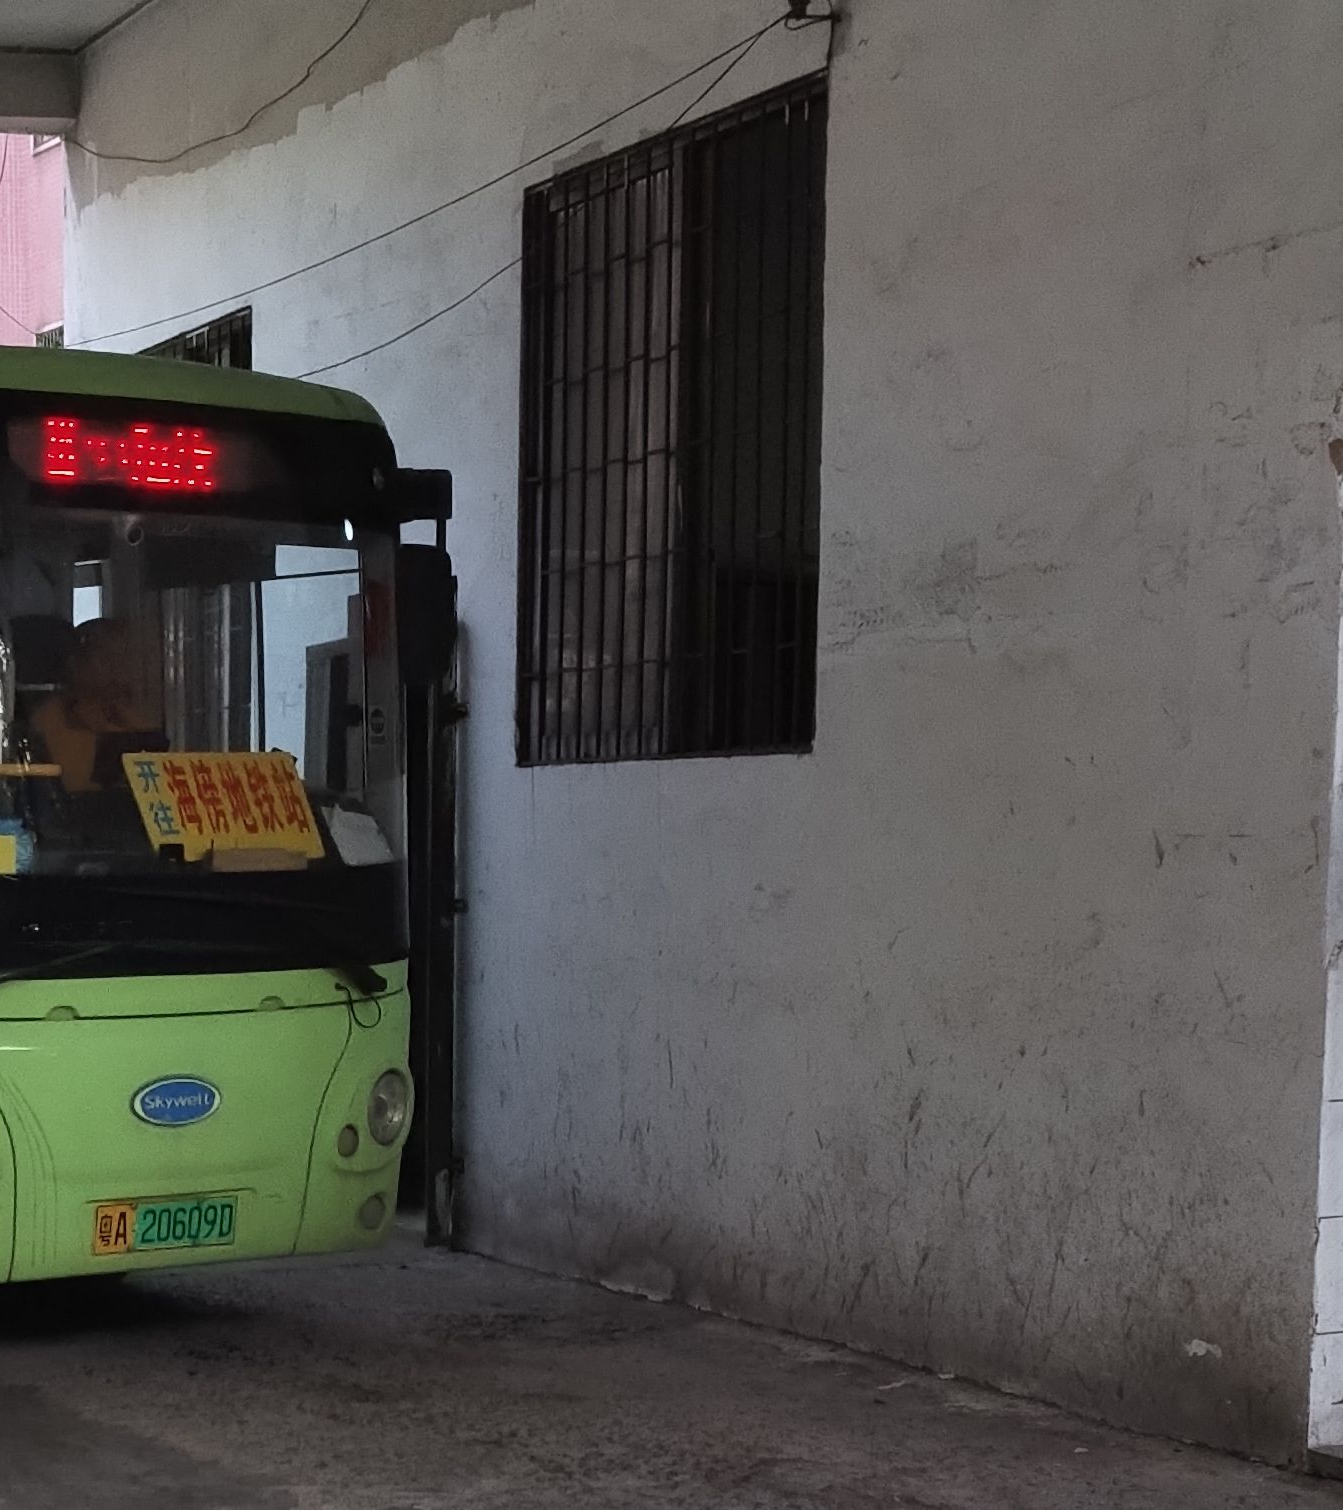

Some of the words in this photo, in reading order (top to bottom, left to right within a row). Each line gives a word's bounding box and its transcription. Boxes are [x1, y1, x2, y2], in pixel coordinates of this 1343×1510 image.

[133, 760, 180, 835] 开往
[162, 759, 311, 836] 海傍地铁站
